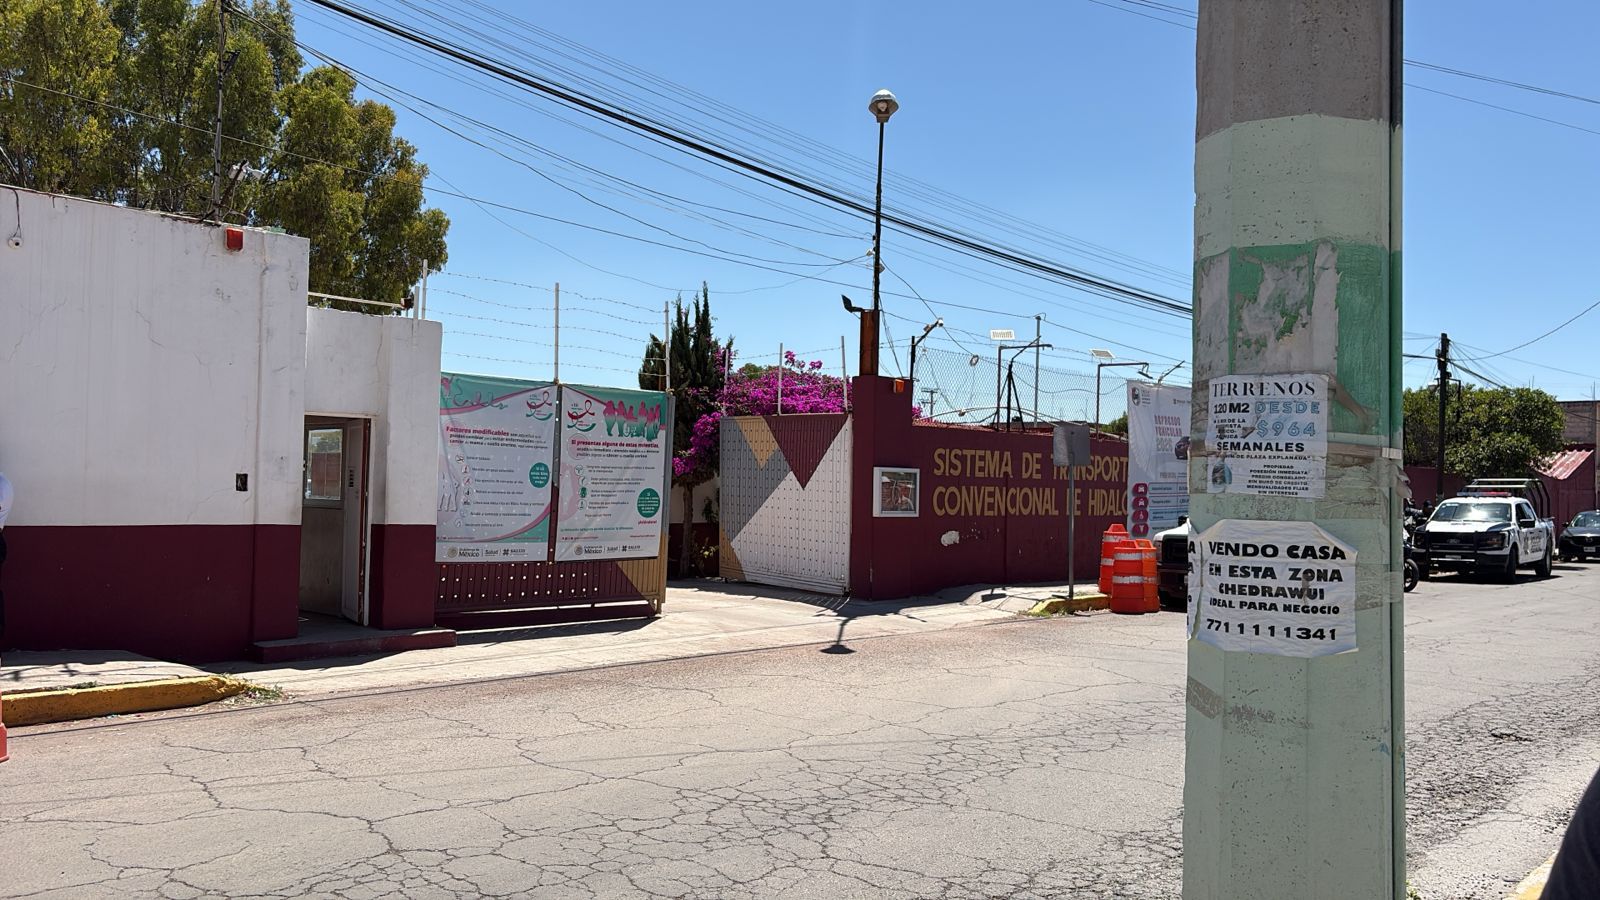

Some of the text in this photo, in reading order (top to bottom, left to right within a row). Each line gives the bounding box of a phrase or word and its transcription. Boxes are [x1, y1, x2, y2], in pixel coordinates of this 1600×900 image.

[1212, 381, 1316, 398] TERRENOS
[1213, 400, 1320, 415] 120 M2 DESDE
[472, 428, 510, 437] modificables
[1256, 420, 1317, 438] $964
[1217, 441, 1305, 452] SEMANALES
[933, 448, 1013, 479] SISTEMA
[1022, 452, 1042, 480] DE
[932, 486, 1059, 517] CONVENCIONAL
[1208, 541, 1279, 559] VENDO
[1286, 544, 1347, 561] CASA
[1209, 563, 1222, 577] EN
[1228, 565, 1277, 580] ESTA
[1288, 567, 1344, 583] ZONA
[1219, 583, 1325, 601] CHEDRAWUI
[1210, 598, 1340, 615] IDEAL PARA NEGOCIO
